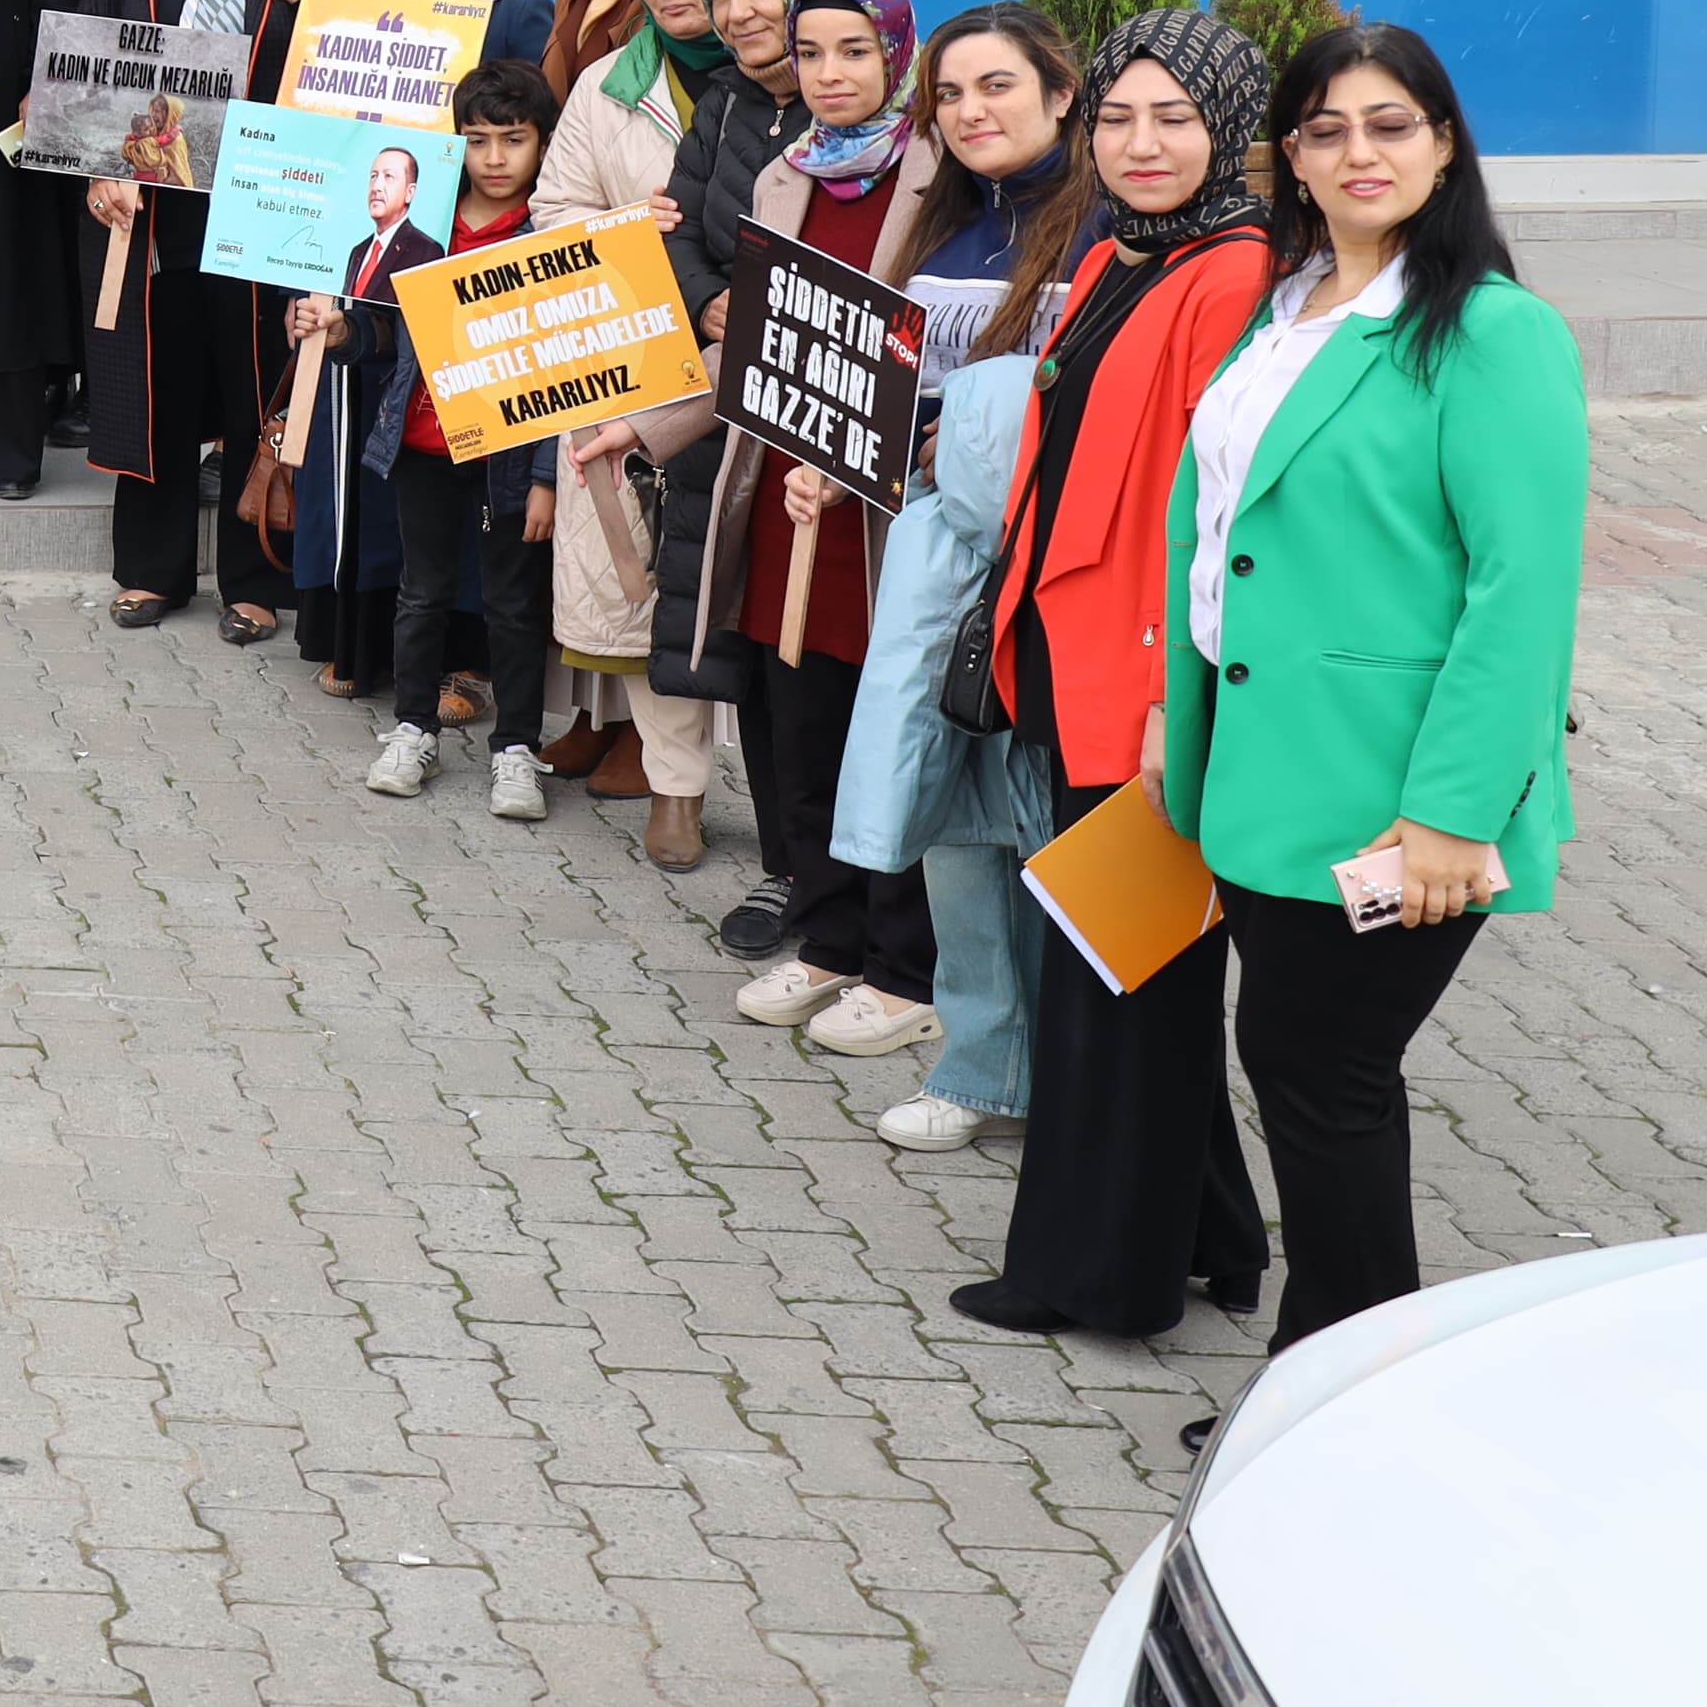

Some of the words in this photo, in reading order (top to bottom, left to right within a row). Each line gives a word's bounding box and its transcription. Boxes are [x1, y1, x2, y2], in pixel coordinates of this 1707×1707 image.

[432, 1, 486, 18] #kararlıyız
[119, 24, 165, 54] GAZZE:
[317, 34, 383, 64] KADINA
[387, 38, 448, 74] ŞİDDET,
[47, 52, 91, 82] KADIN
[94, 58, 111, 85] VE
[160, 66, 233, 99] MEZARLIĞI
[297, 59, 387, 100] İNSANLIĞA
[392, 71, 455, 107] İHANET
[240, 126, 275, 142] Kadına
[281, 167, 325, 185] şiddeti
[256, 198, 286, 213] kabul
[289, 204, 324, 220] etmez.
[584, 205, 651, 233] #kararlıyız
[452, 239, 601, 305] KADIN-ERKEK
[465, 306, 534, 349] OMUZ
[534, 282, 619, 329] OMUZA
[766, 261, 885, 362] ŞİDDETİN
[431, 346, 533, 402] ŞİDDETLE
[532, 303, 679, 369] MÜCADELEDE
[761, 318, 799, 375] EN
[804, 340, 876, 418] AĞIRI
[886, 333, 919, 368] STOP!
[499, 364, 641, 426] KARARLIYIZ.
